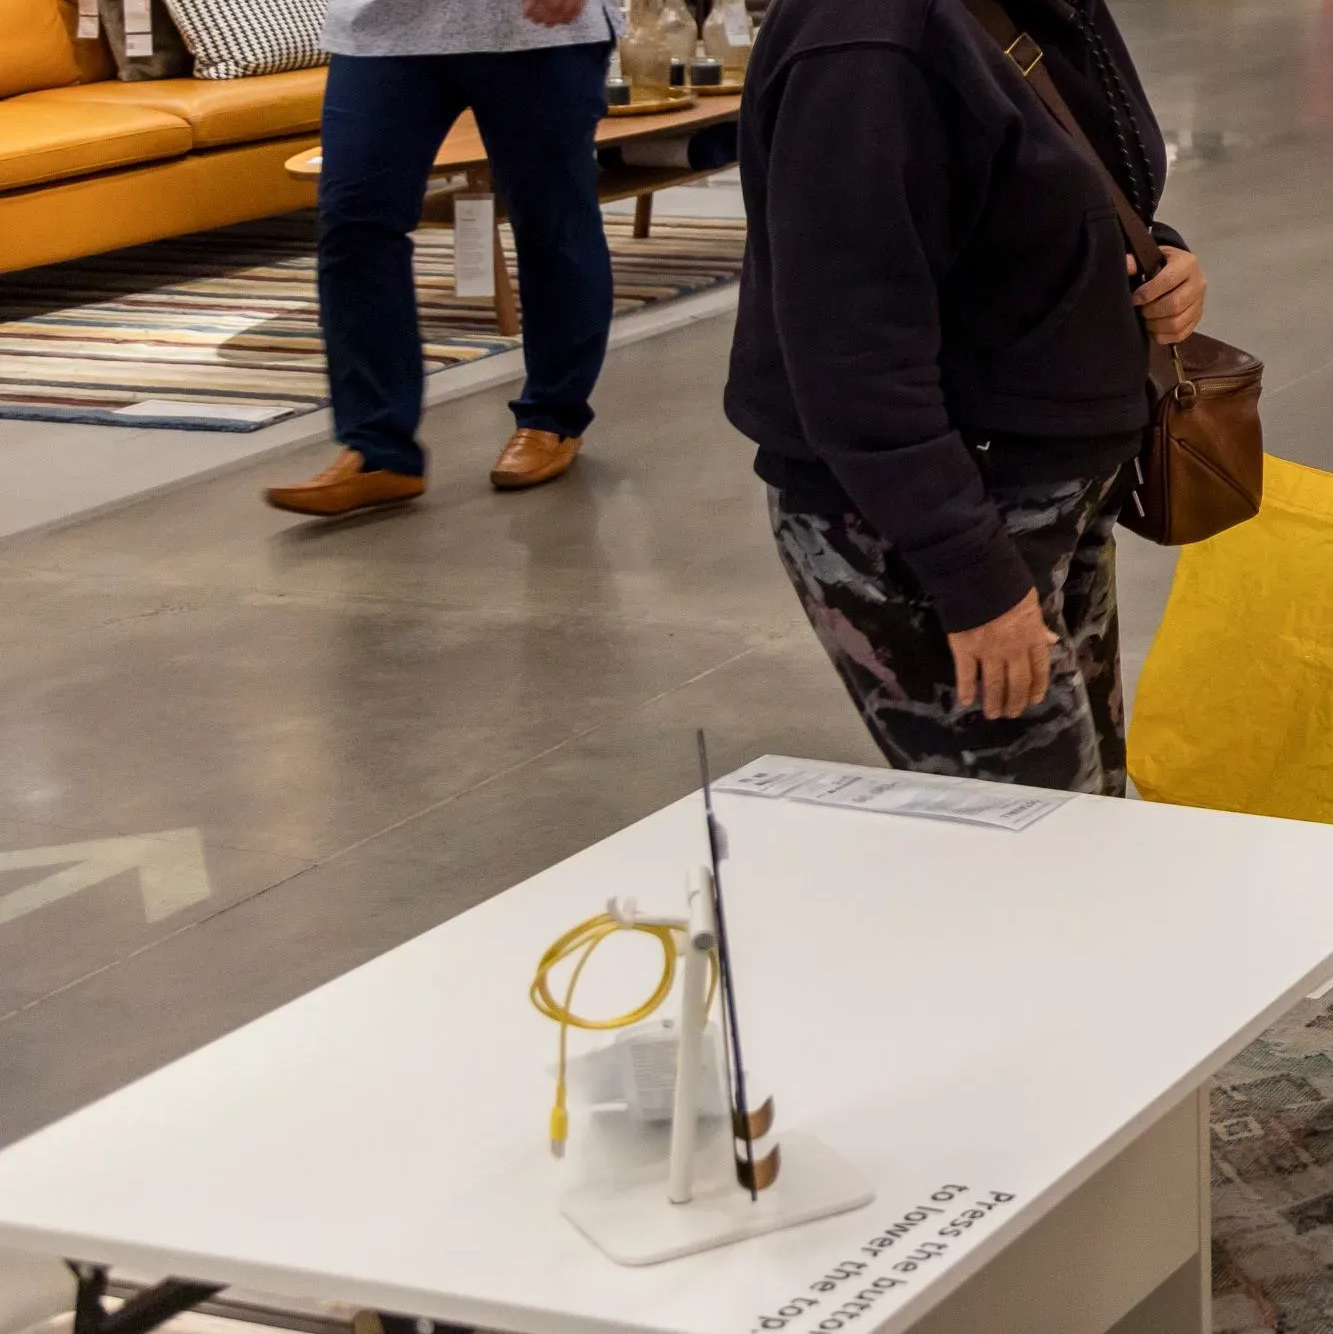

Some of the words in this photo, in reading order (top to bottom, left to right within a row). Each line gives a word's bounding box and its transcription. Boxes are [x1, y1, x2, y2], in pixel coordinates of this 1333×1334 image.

[930, 1183, 970, 1203] to
[938, 1190, 1018, 1238] Press
[860, 1205, 946, 1258] lower
[892, 1241, 949, 1273] the
[809, 1260, 869, 1293] the
